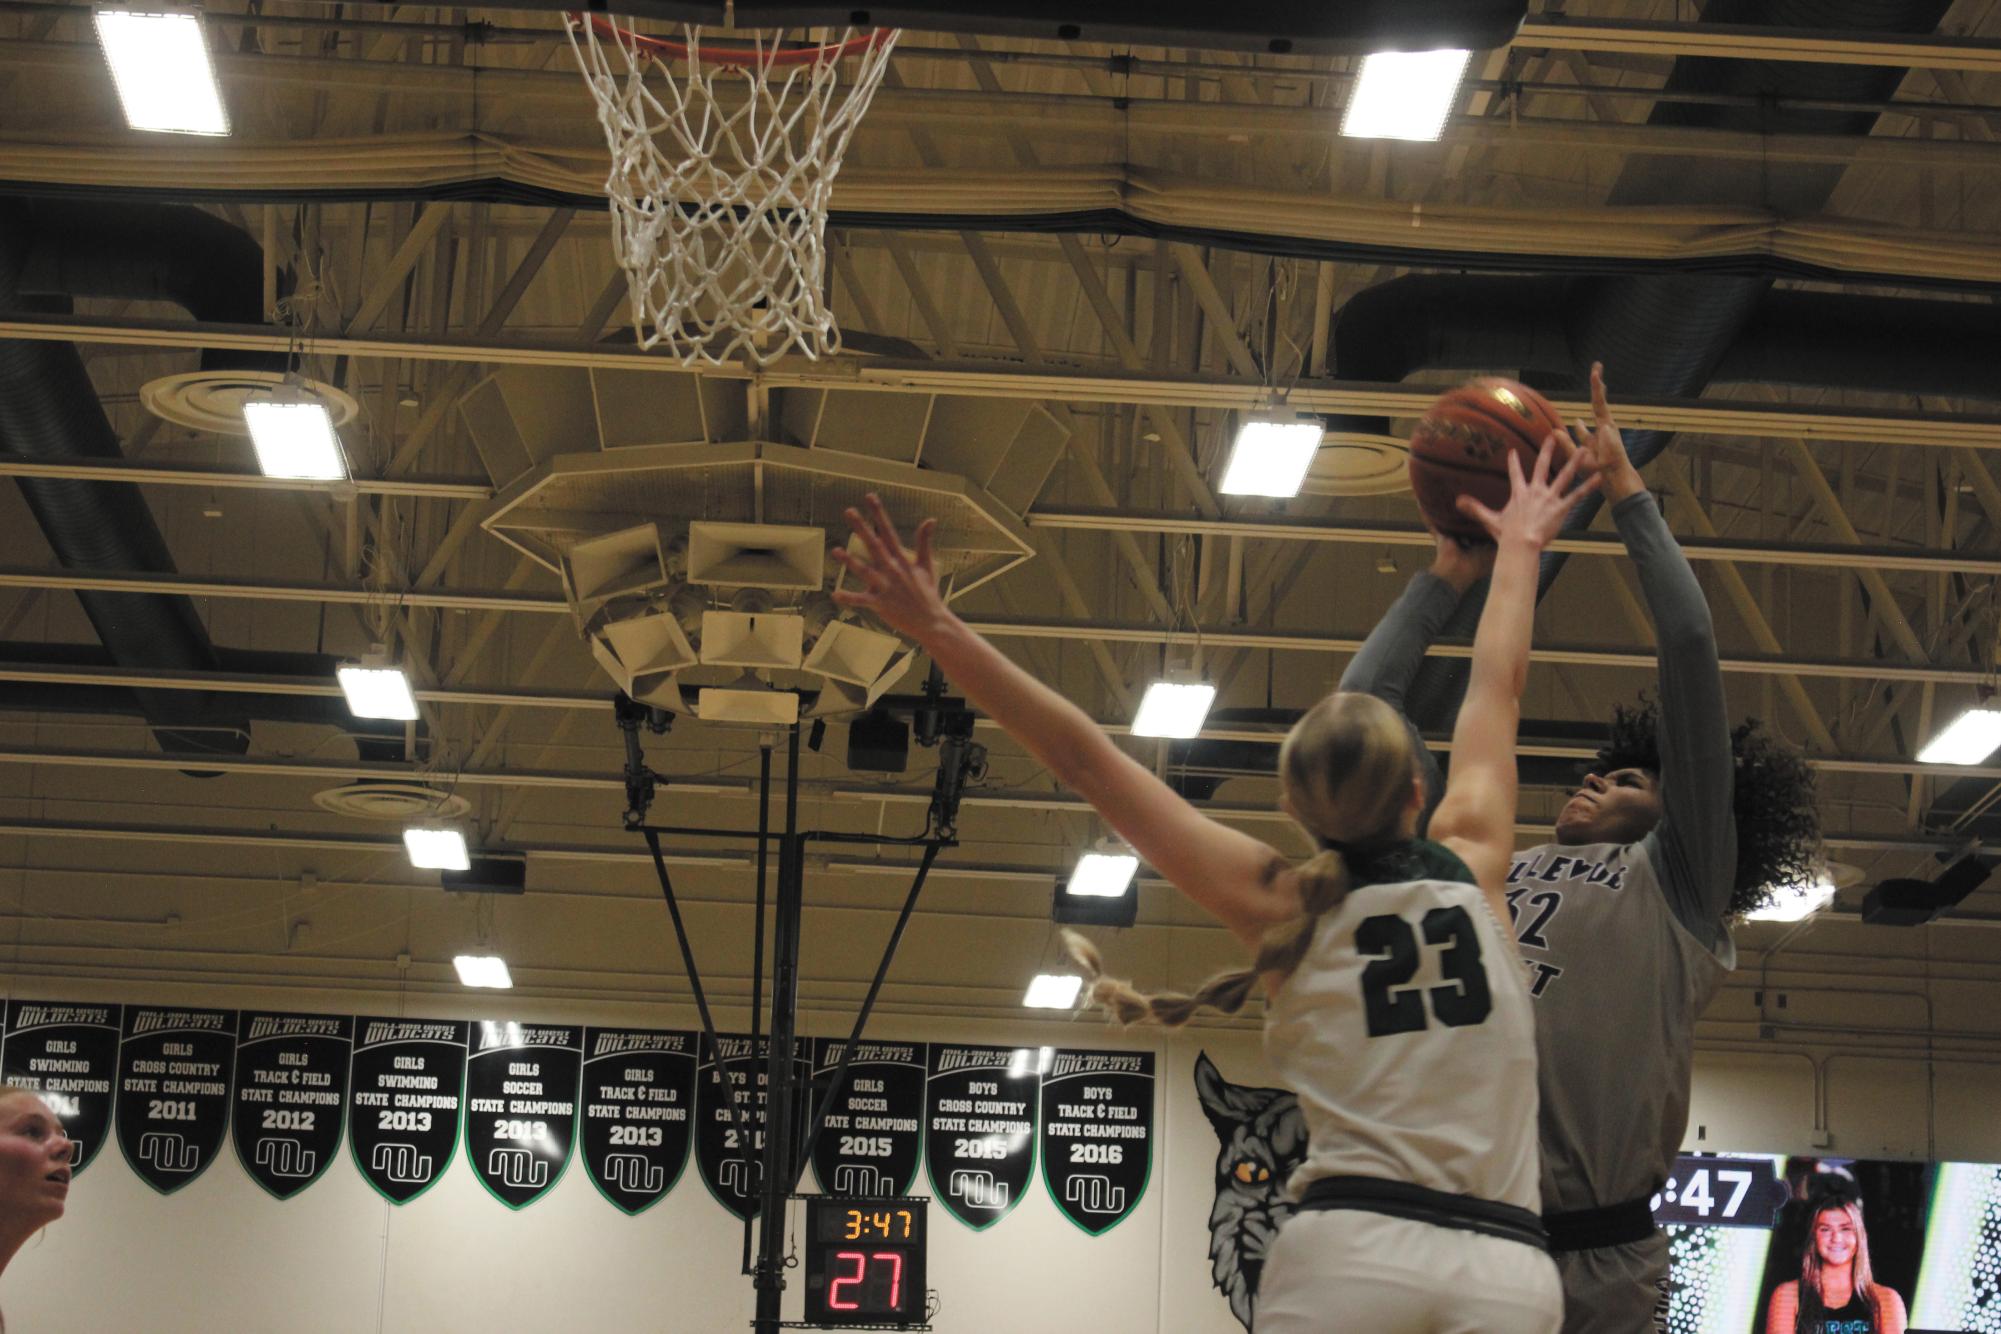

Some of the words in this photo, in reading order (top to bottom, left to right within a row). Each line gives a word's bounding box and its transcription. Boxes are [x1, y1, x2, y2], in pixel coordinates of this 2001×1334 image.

[1355, 905, 1492, 1037] 23
[45, 1040, 77, 1053] GIRLS
[163, 1043, 193, 1056] GIRLS
[29, 1058, 90, 1073] SWIMMING
[278, 1052, 308, 1066] GIRLS
[394, 1056, 425, 1070] GIRLS
[133, 1060, 166, 1074] CROSS
[169, 1062, 220, 1076] COUNTRY
[509, 1062, 540, 1076] GIRLS
[624, 1069, 654, 1082] GIRLS
[6, 1077, 40, 1090] STATE
[46, 1078, 109, 1093] CHAMPIONS
[254, 1070, 289, 1084] TRACK
[302, 1072, 331, 1086] FIELD
[378, 1074, 438, 1089] SWIMMING
[712, 1071, 746, 1084] BYS
[853, 1079, 884, 1092] GIRLS
[124, 1079, 157, 1092] STATE
[163, 1080, 225, 1095] CHAMPIONS
[503, 1081, 543, 1095] SOCCER
[600, 1086, 635, 1100] TRACK
[648, 1088, 677, 1101] FIELD
[969, 1082, 998, 1095] BOYS
[1083, 1086, 1113, 1100] BOYS
[241, 1089, 273, 1102] STATE
[279, 1090, 340, 1105] CHAMPIONS
[355, 1092, 389, 1106] STATE
[394, 1094, 458, 1109] CHAMPIONS
[848, 1098, 888, 1111] SOCCER
[148, 1100, 197, 1120] 2011
[471, 1099, 504, 1112] STATE
[509, 1100, 573, 1115] CHAMPIONS
[588, 1104, 620, 1118] STATE
[626, 1106, 686, 1121] CHAMPIONS
[939, 1099, 972, 1112] CROSS
[975, 1101, 1026, 1115] COUNTRY
[1058, 1104, 1094, 1118] TRACK
[1108, 1106, 1137, 1119] FIELD
[262, 1110, 315, 1130] 2012
[378, 1110, 432, 1131] 2013
[824, 1115, 849, 1128] TATE
[855, 1117, 918, 1132] CHAMPIONS
[933, 1118, 966, 1131] STATE
[968, 1120, 1031, 1134] CHAMPIONS
[494, 1119, 547, 1141] 2013
[609, 1125, 662, 1146] 2013
[1048, 1123, 1081, 1136] STATE
[1083, 1124, 1146, 1139] CHAMPIONS
[840, 1136, 892, 1157] 2015
[954, 1139, 1007, 1159] 2015
[1069, 1143, 1123, 1164] 2016
[845, 1210, 912, 1240] 3:47
[829, 1252, 902, 1310] 27
